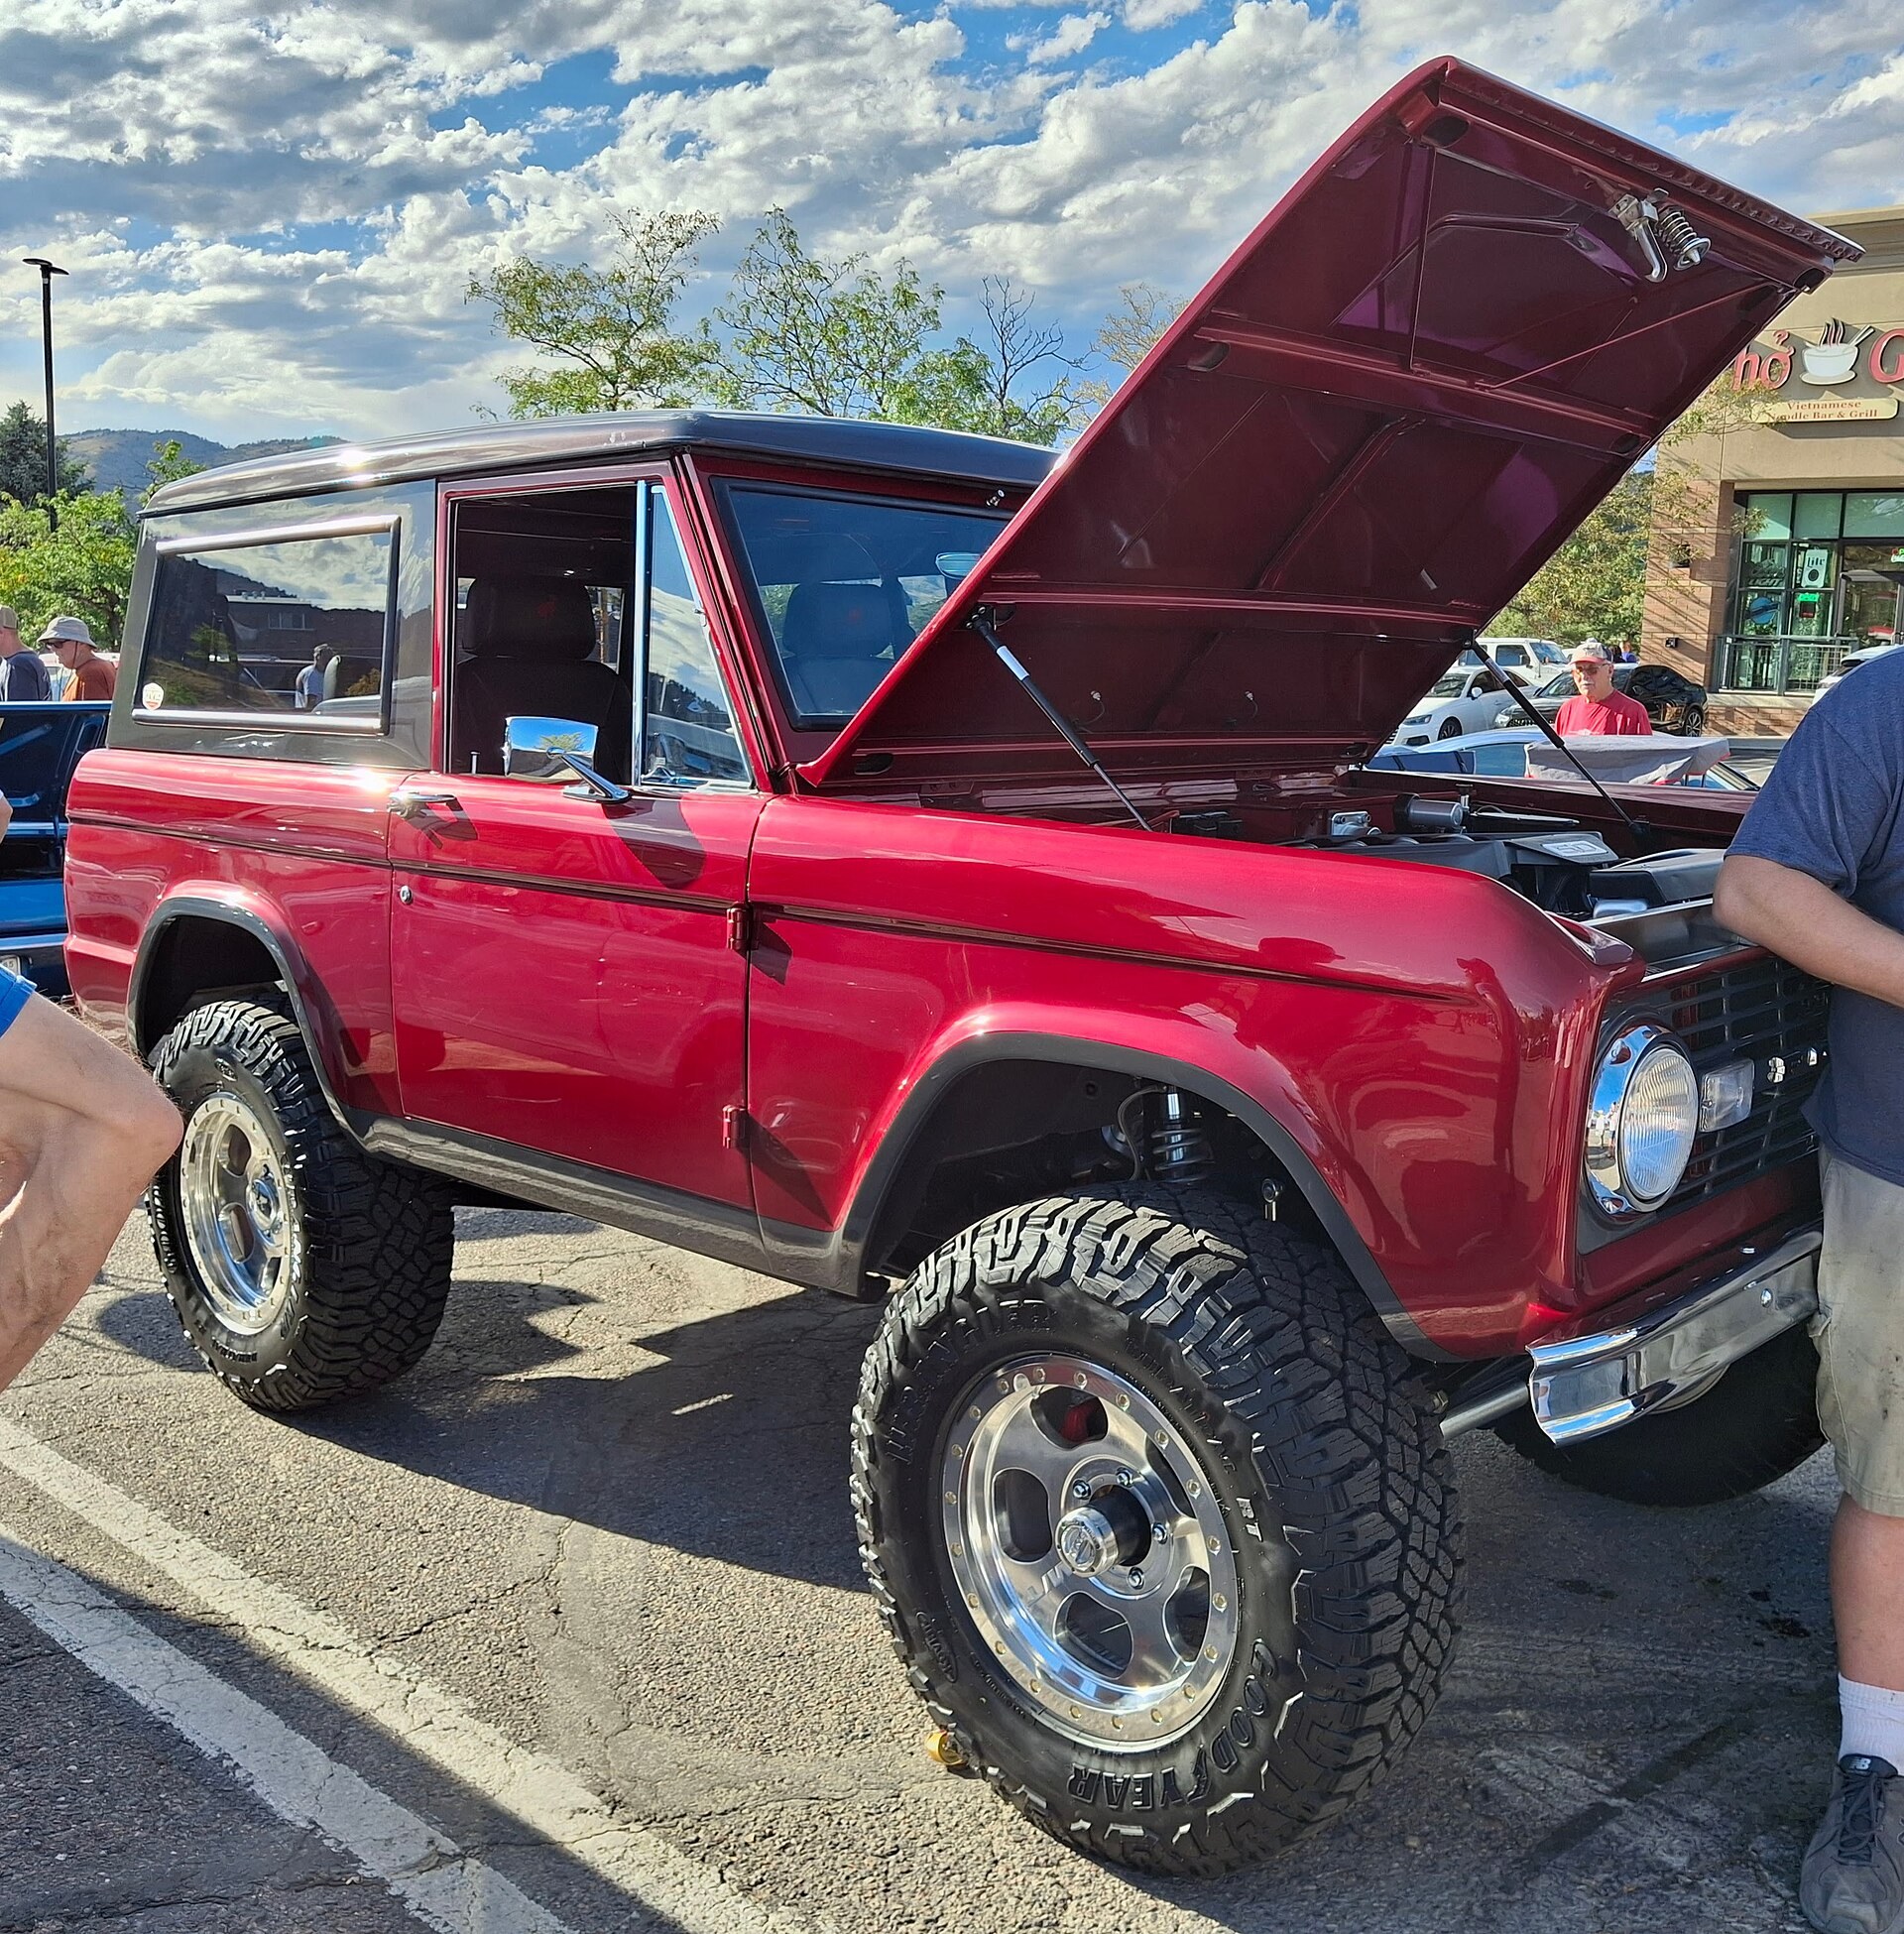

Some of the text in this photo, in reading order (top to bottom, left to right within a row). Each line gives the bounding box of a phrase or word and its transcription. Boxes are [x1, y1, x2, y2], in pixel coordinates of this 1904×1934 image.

[1731, 329, 1794, 391] hở
[1787, 401, 1861, 411] Vietnamese
[1813, 409, 1833, 420] Bar
[1837, 409, 1845, 419] &
[1849, 409, 1877, 418] Grill
[1747, 577, 1783, 587] LIGHT
[1066, 1637, 1278, 1810] GOODYEAR
